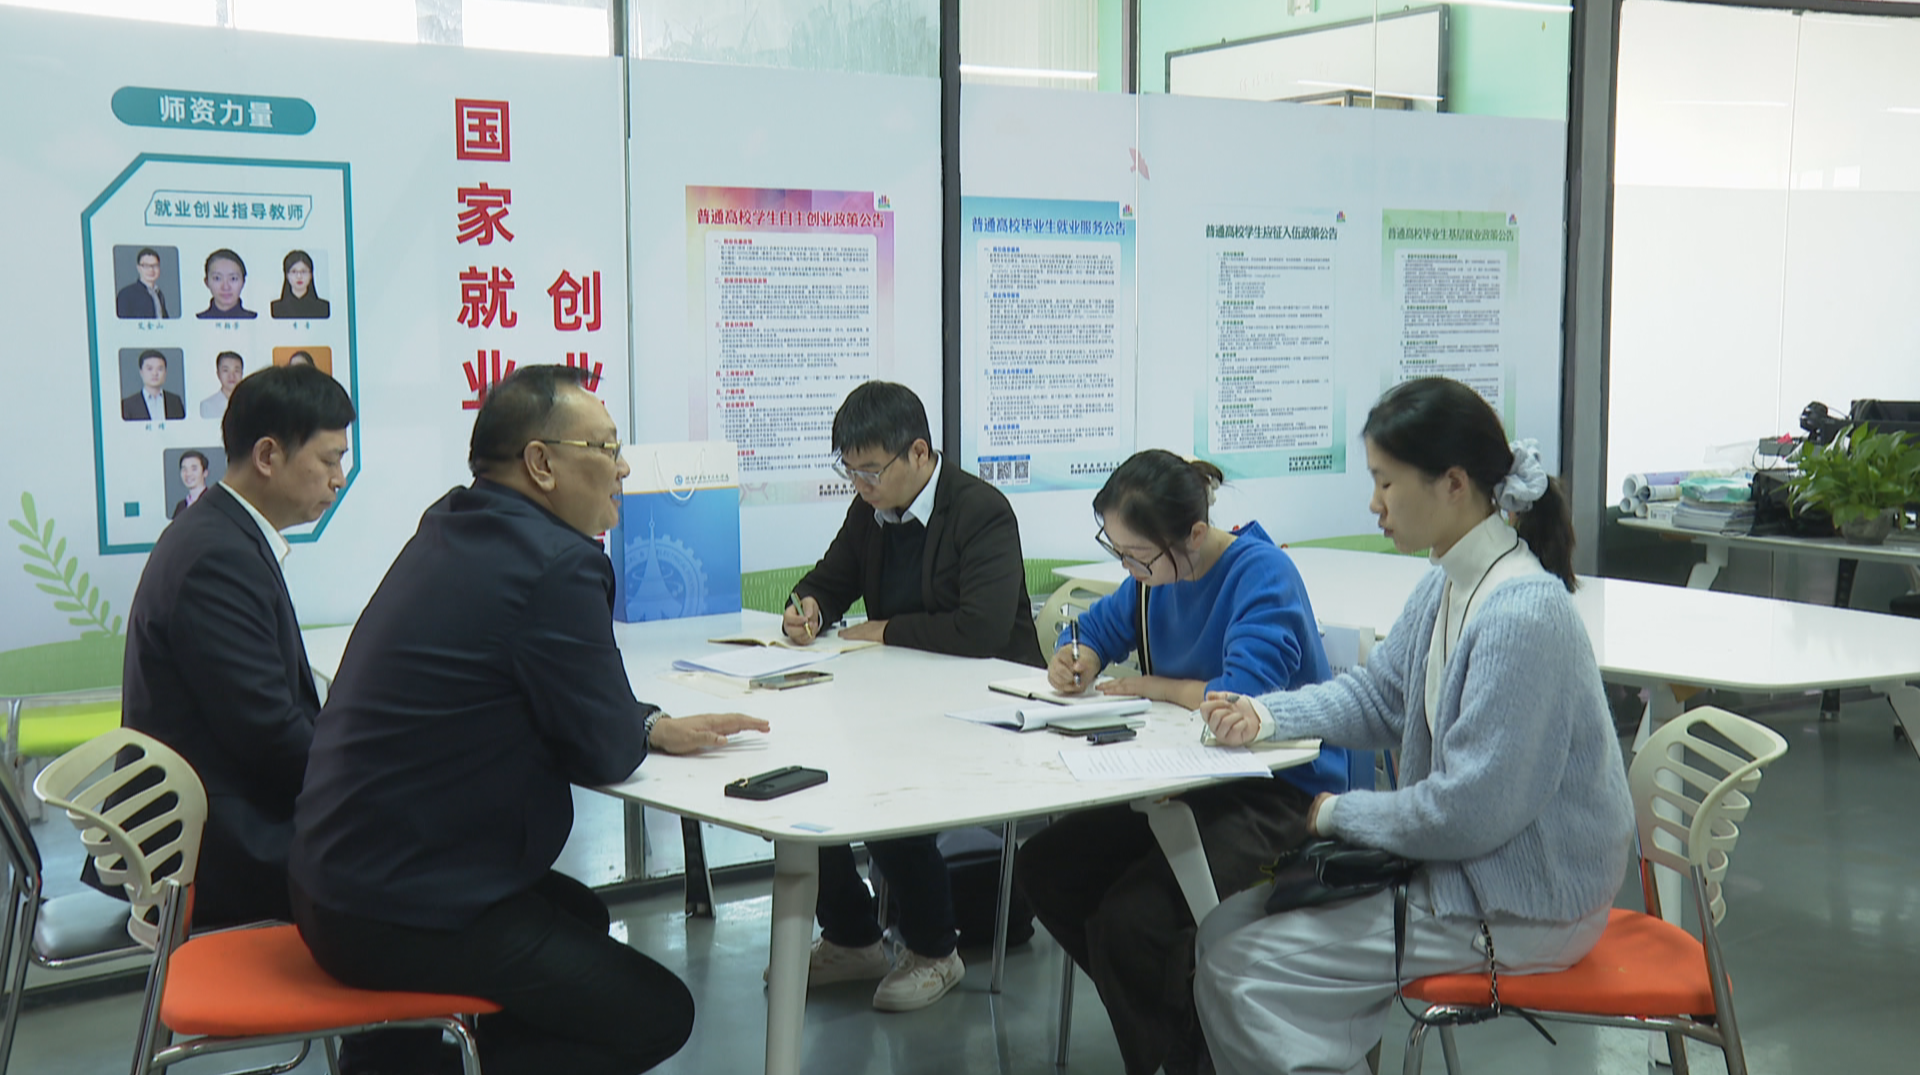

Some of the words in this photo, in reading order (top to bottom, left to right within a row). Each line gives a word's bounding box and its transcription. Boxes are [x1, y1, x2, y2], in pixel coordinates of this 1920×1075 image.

[159, 95, 274, 128] 师资力量
[153, 199, 304, 222] 就业创业指导教师
[697, 208, 885, 228] 普通高校学生自主创业政策公告
[972, 216, 1127, 236] 普通高校毕业生就业服务公告
[1205, 224, 1338, 241] 普通高校学生应征入伍政策公告
[1388, 227, 1515, 242] 普通高校毕业生基层就业政策公告
[455, 98, 518, 410] 国家就业
